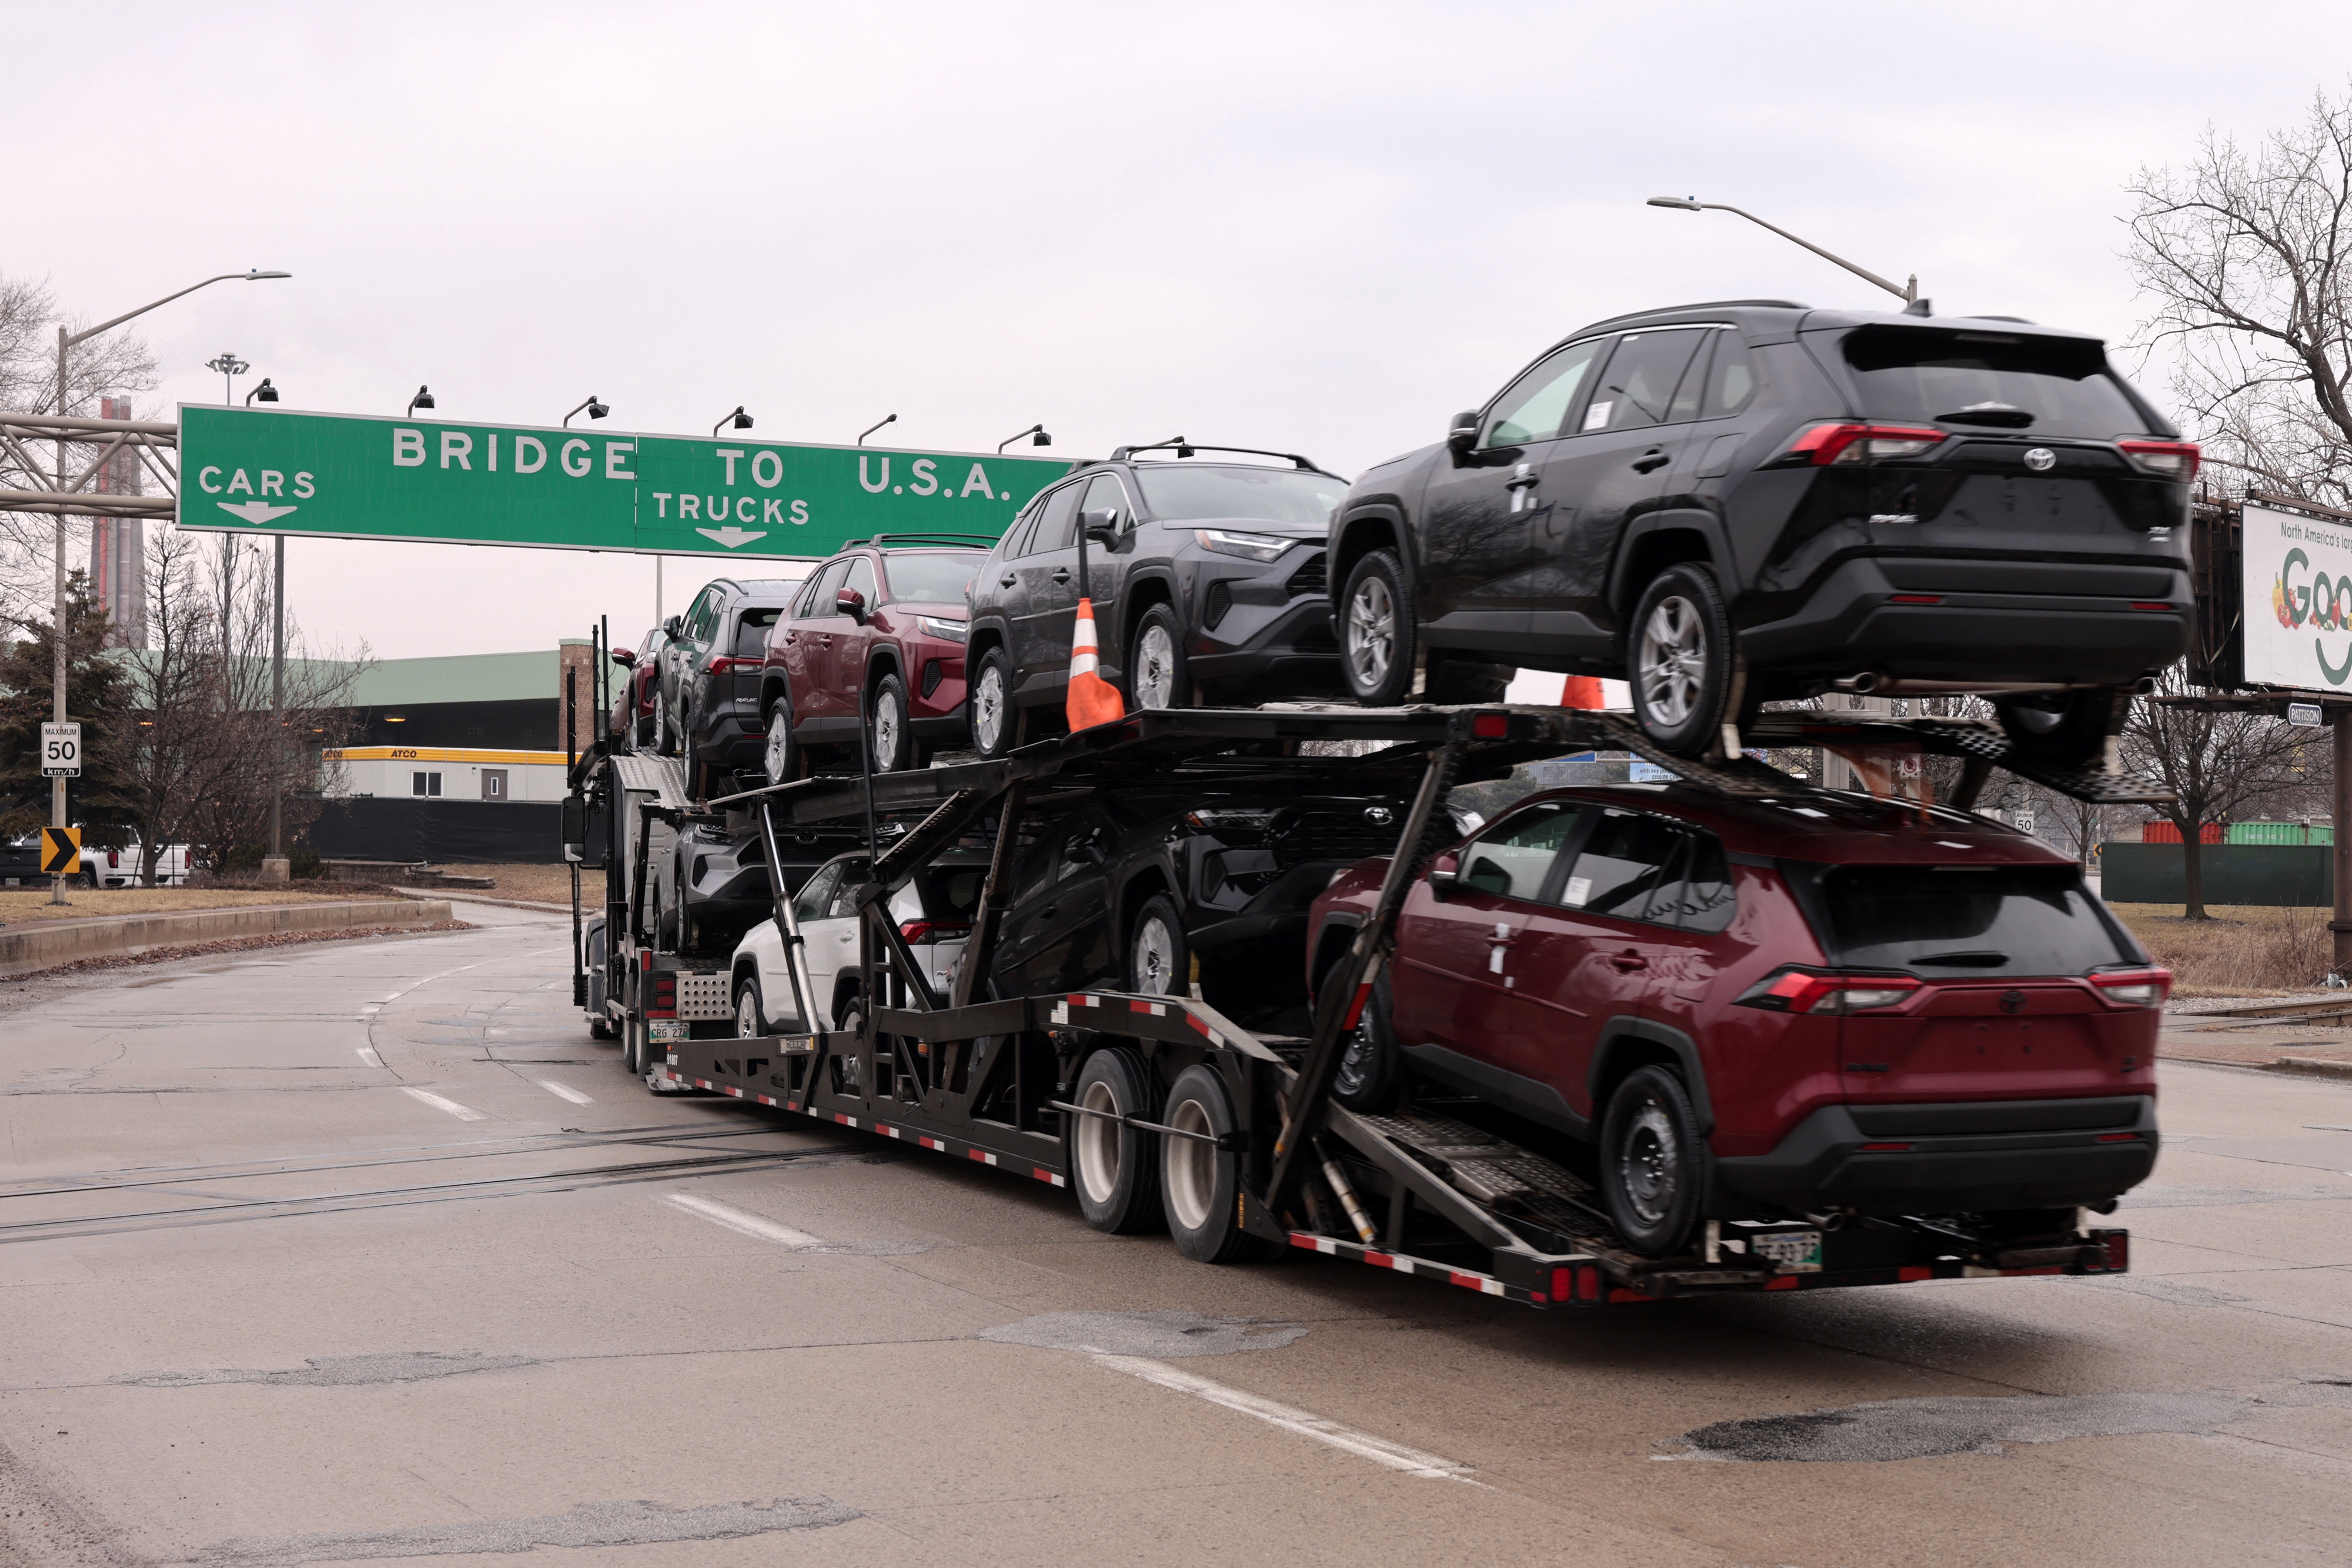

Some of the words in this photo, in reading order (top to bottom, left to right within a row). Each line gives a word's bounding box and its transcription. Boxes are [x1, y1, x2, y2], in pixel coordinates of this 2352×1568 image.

[393, 427, 636, 481] BRIDGE
[716, 448, 784, 488] TO
[858, 455, 1011, 501] U.S.A.
[199, 465, 316, 499] CARS
[652, 492, 809, 526] TRUCKS
[2281, 521, 2302, 540] North
[2304, 526, 2340, 548] America's
[2341, 533, 2352, 554] lar
[2291, 708, 2320, 723] PATTISON
[47, 741, 75, 760] 50
[390, 750, 417, 758] ATCO
[2017, 820, 2032, 831] 50
[651, 1028, 667, 1038] CRG
[672, 1028, 688, 1038] 278
